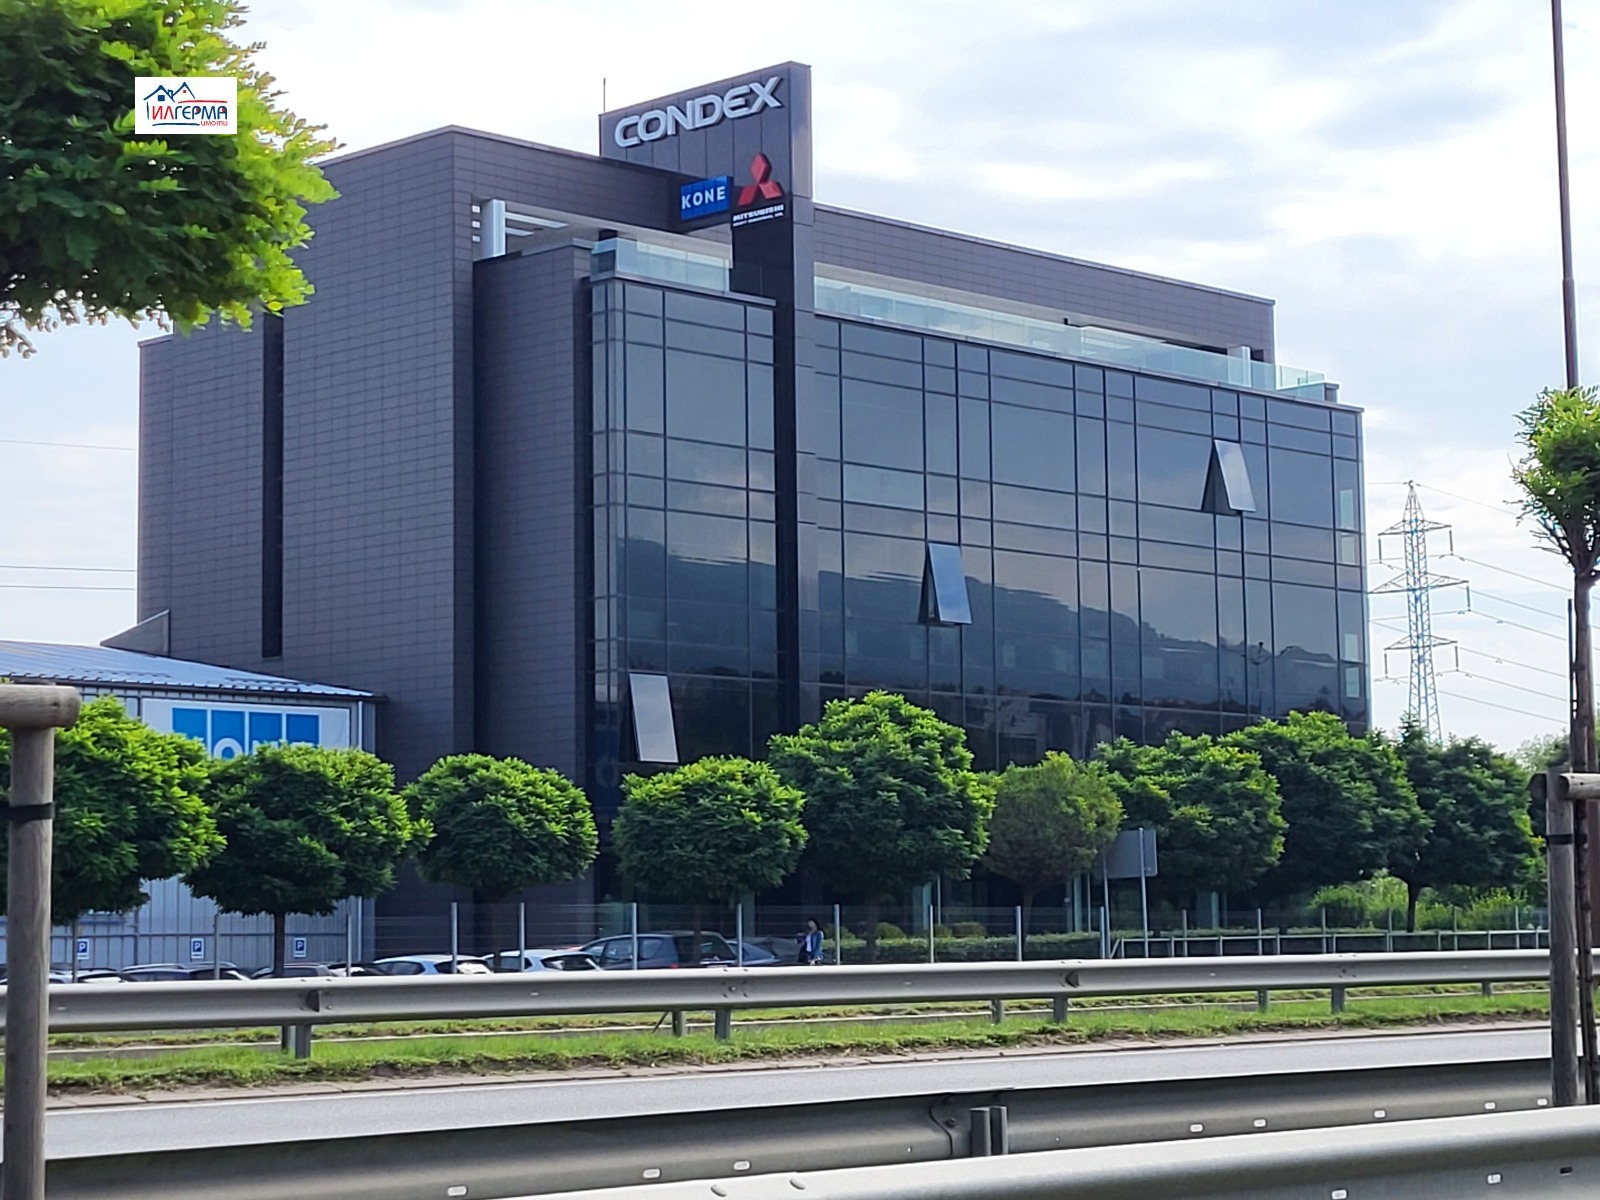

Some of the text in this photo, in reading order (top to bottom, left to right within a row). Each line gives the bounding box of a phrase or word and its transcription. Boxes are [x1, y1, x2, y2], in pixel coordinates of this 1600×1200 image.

[615, 76, 781, 148] CONDEX
[681, 186, 726, 210] KONE
[733, 204, 784, 222] MITSUBISHI
